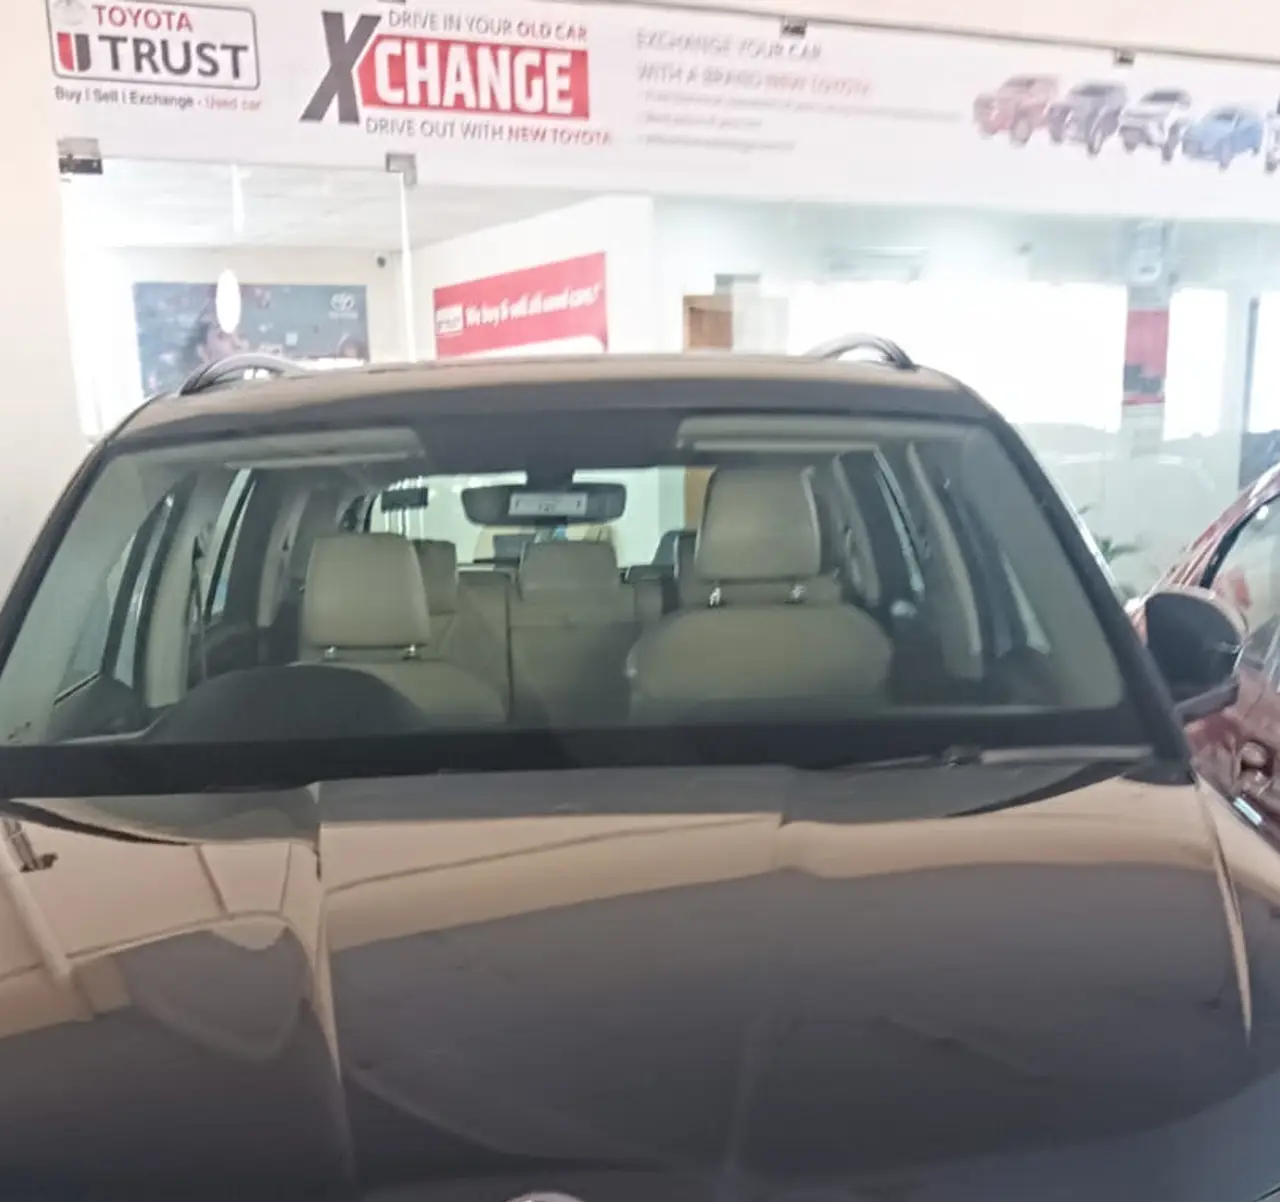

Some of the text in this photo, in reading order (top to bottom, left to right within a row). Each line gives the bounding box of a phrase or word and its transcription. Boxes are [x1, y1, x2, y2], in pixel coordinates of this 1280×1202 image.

[92, 4, 193, 33] TOYOTA
[388, 9, 587, 42] DRIVE IN YOUR OLD CAR
[98, 34, 249, 80] TRUST
[299, 10, 573, 125] XCHANGE
[55, 85, 82, 104] Buy
[93, 87, 118, 103] Sell
[130, 91, 193, 111] Exchange
[366, 117, 613, 147] DRIVE OUT WITH NEW TOYOTA
